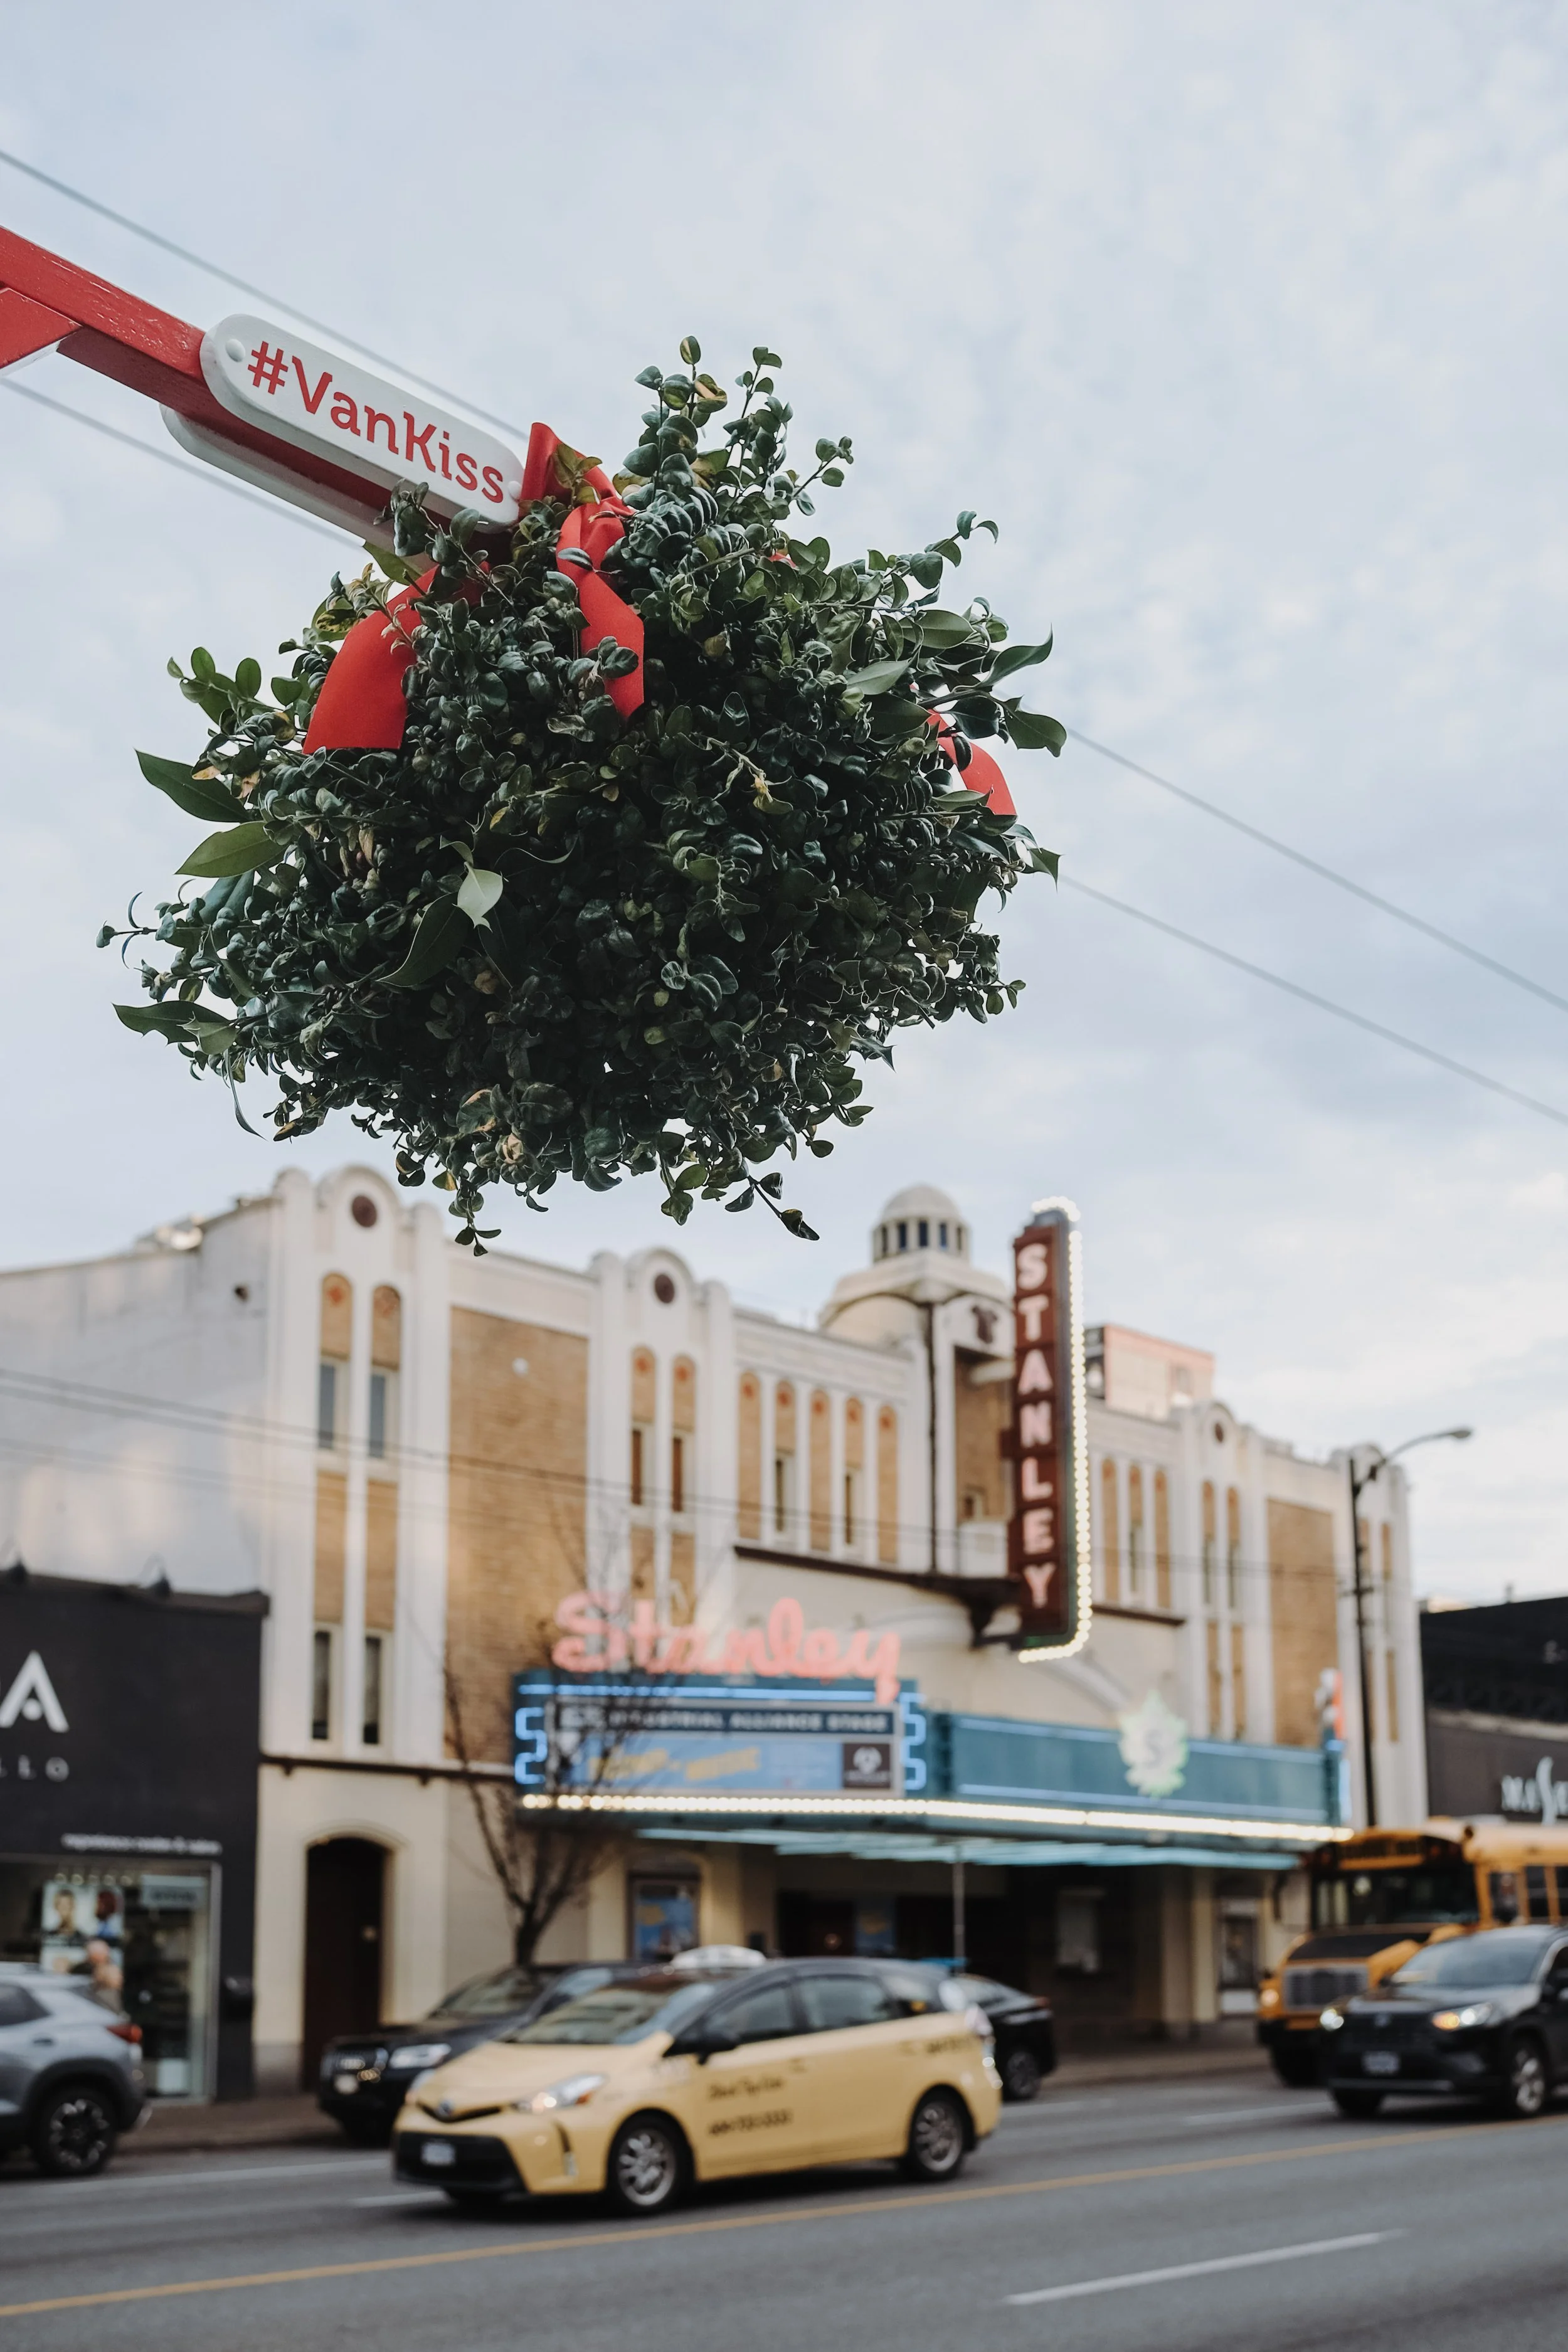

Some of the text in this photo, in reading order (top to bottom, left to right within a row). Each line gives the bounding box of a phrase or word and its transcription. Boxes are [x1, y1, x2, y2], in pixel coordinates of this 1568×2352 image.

[248, 341, 504, 503] #VanKiss
[1017, 1242, 1056, 1609] STANLEY
[551, 1591, 901, 1706] Stanley
